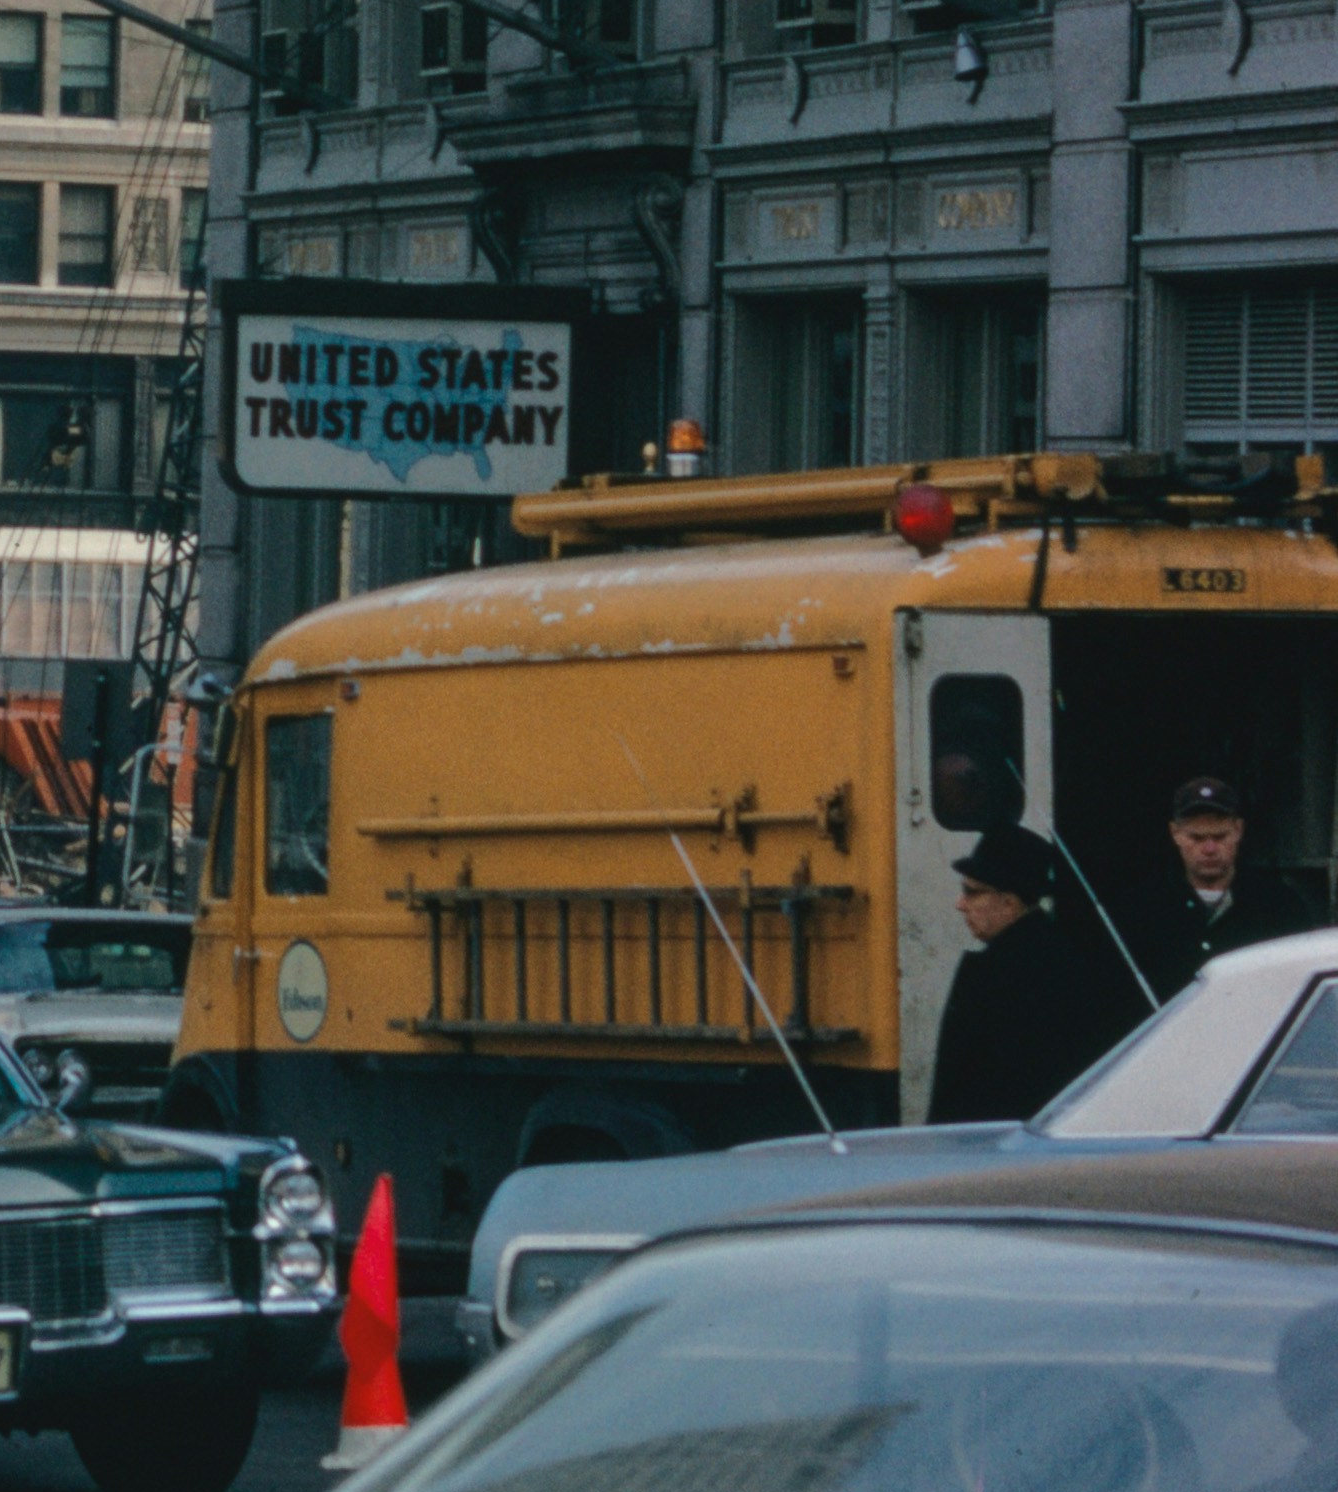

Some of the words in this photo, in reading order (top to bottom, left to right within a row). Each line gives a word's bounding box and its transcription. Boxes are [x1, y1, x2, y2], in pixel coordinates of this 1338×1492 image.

[250, 341, 398, 386] UNITED
[418, 347, 560, 392] STATES
[245, 396, 369, 440] TRUST
[383, 400, 564, 447] COMPANY
